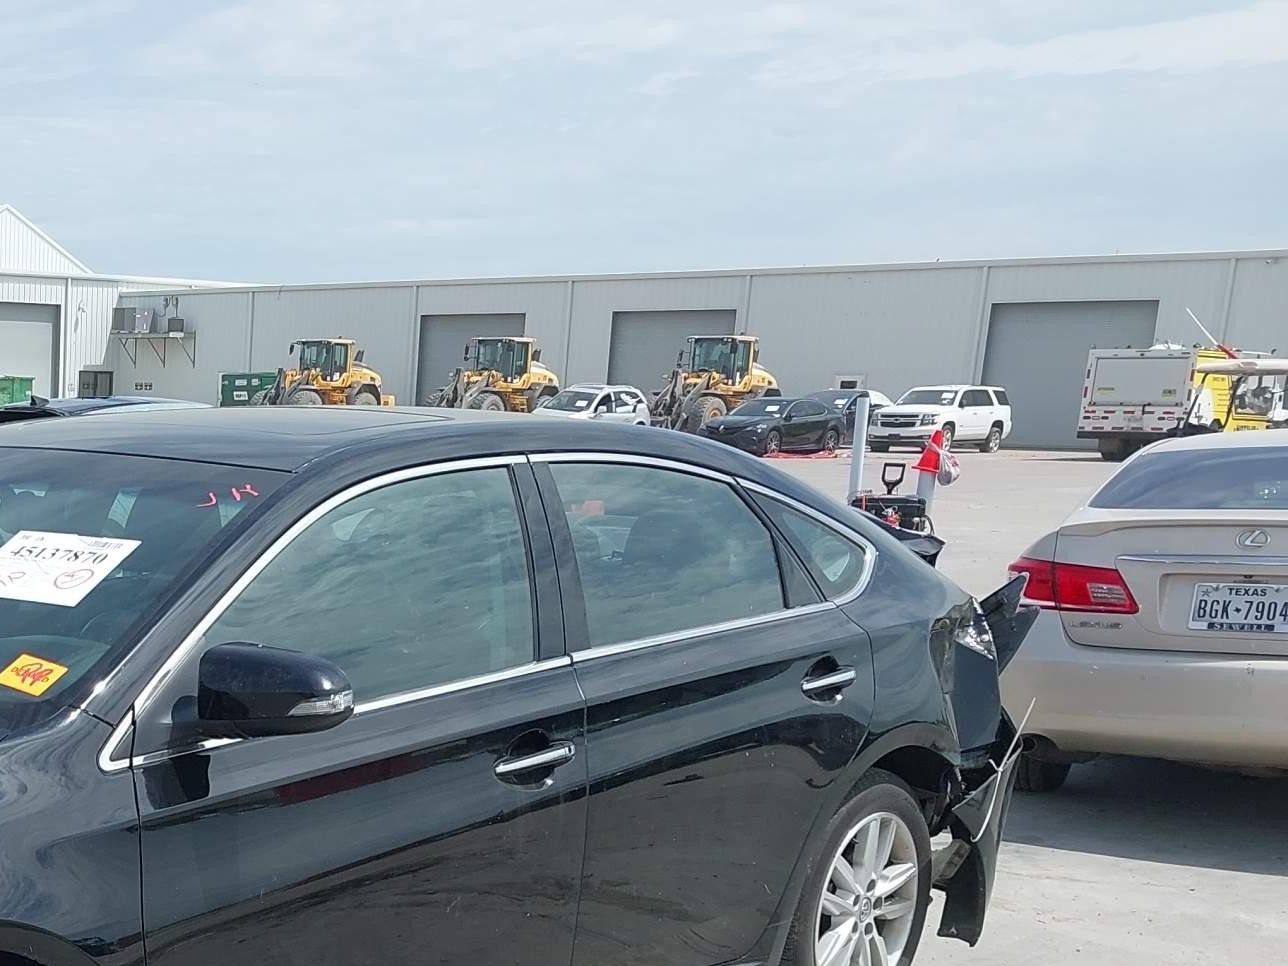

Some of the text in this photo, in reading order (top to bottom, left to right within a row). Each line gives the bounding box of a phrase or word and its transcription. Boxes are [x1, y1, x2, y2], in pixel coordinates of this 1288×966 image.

[10, 545, 109, 565] 45137870
[1227, 587, 1268, 597] TEXAS
[1197, 599, 1288, 622] BGK 7904
[1070, 620, 1123, 629] LEXUS
